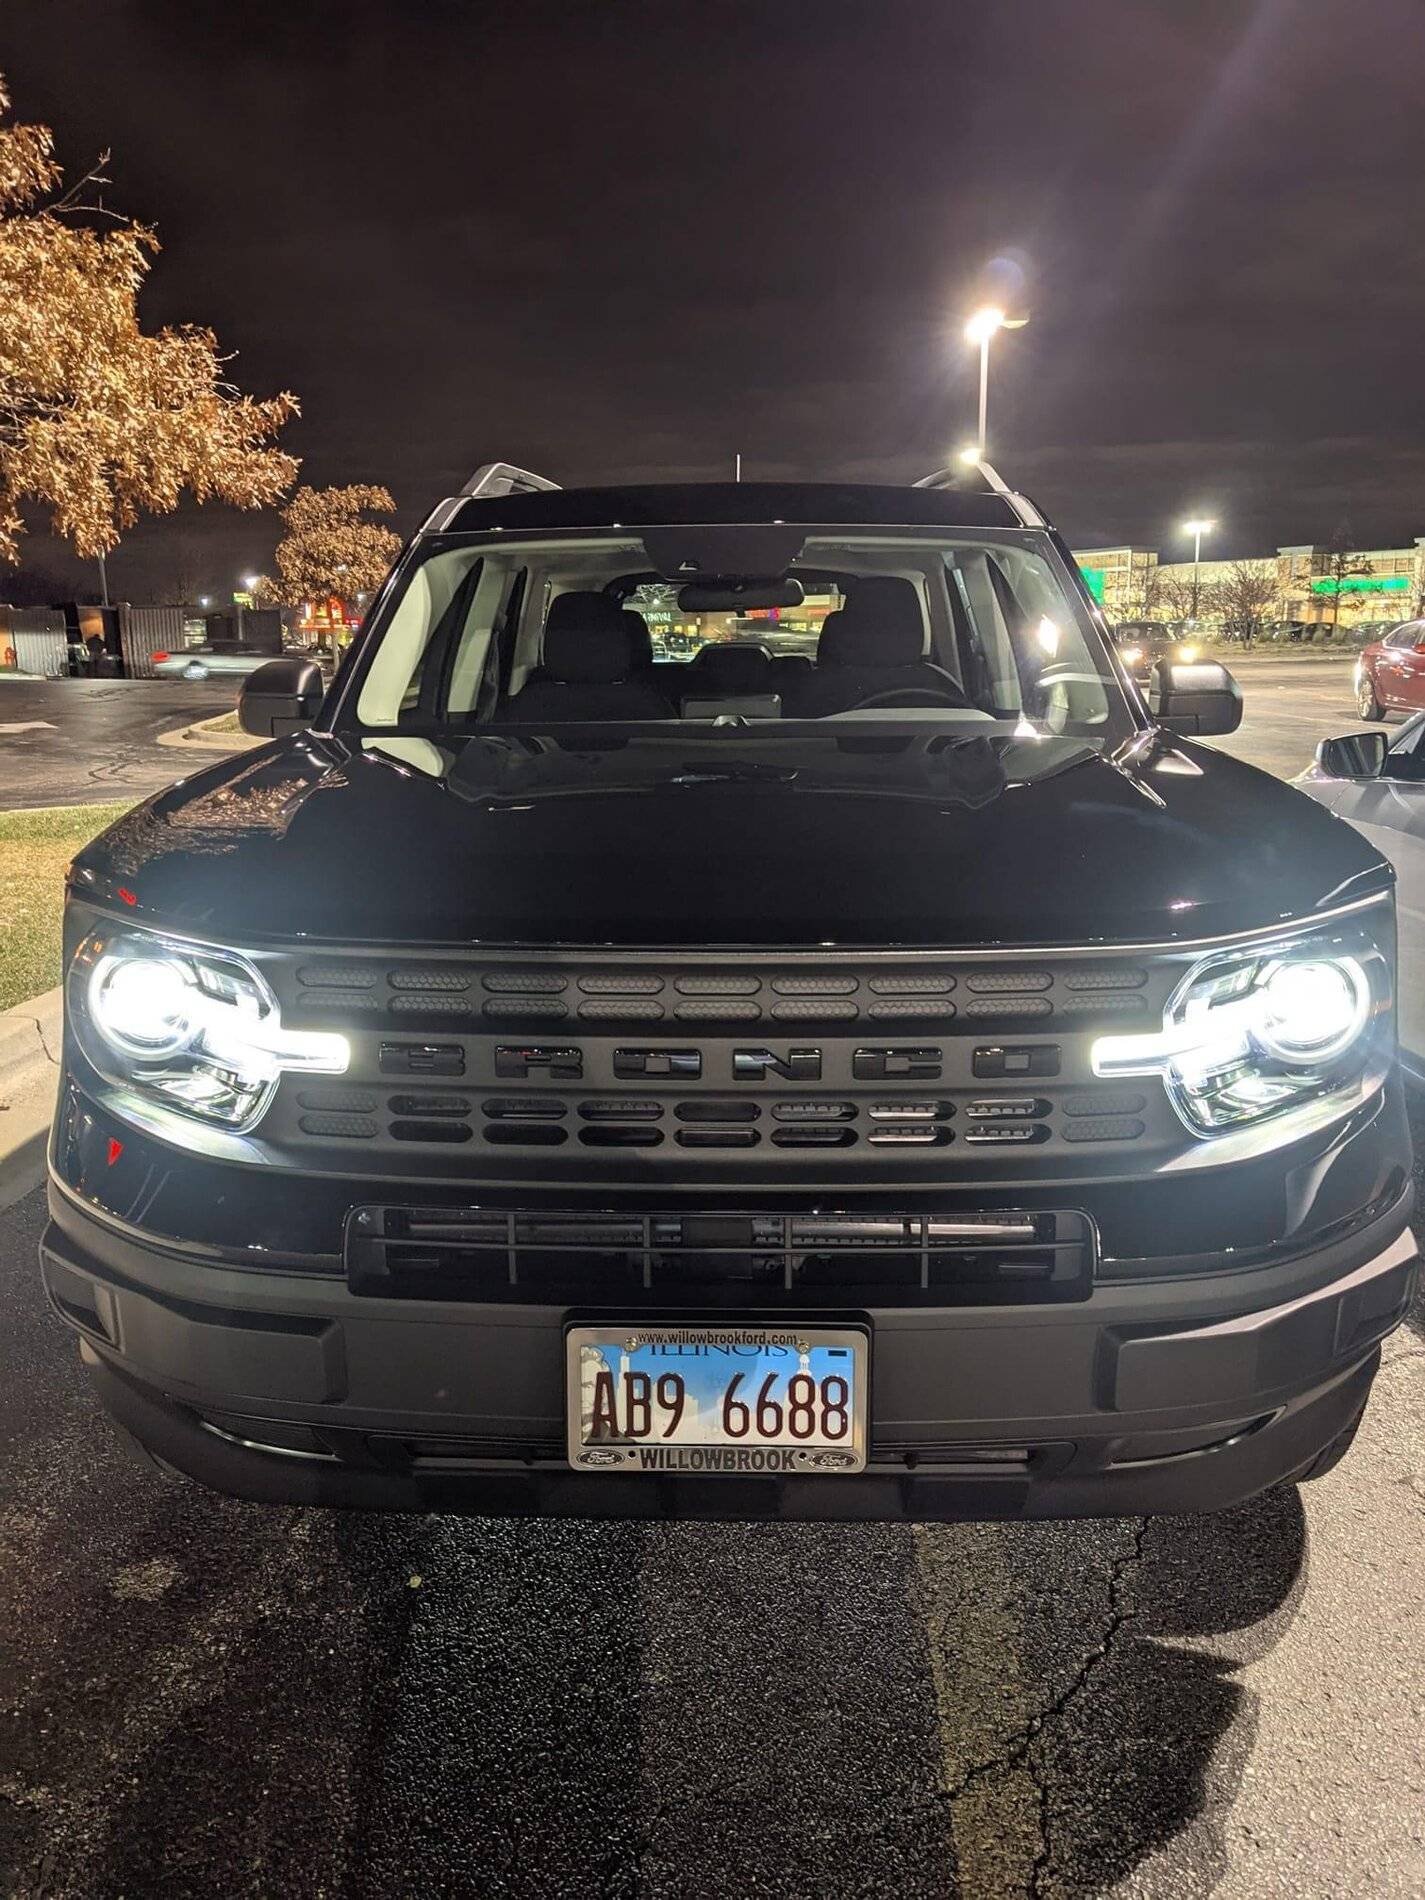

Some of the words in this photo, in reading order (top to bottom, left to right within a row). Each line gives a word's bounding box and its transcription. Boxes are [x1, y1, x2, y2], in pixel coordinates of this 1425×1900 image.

[379, 1042, 1061, 1081] BRONCO
[638, 1331, 797, 1346] www.willowbrookford.com
[591, 1371, 686, 1439] AB9
[722, 1371, 849, 1440] 6688
[640, 1449, 797, 1470] WILLOWBROOK
